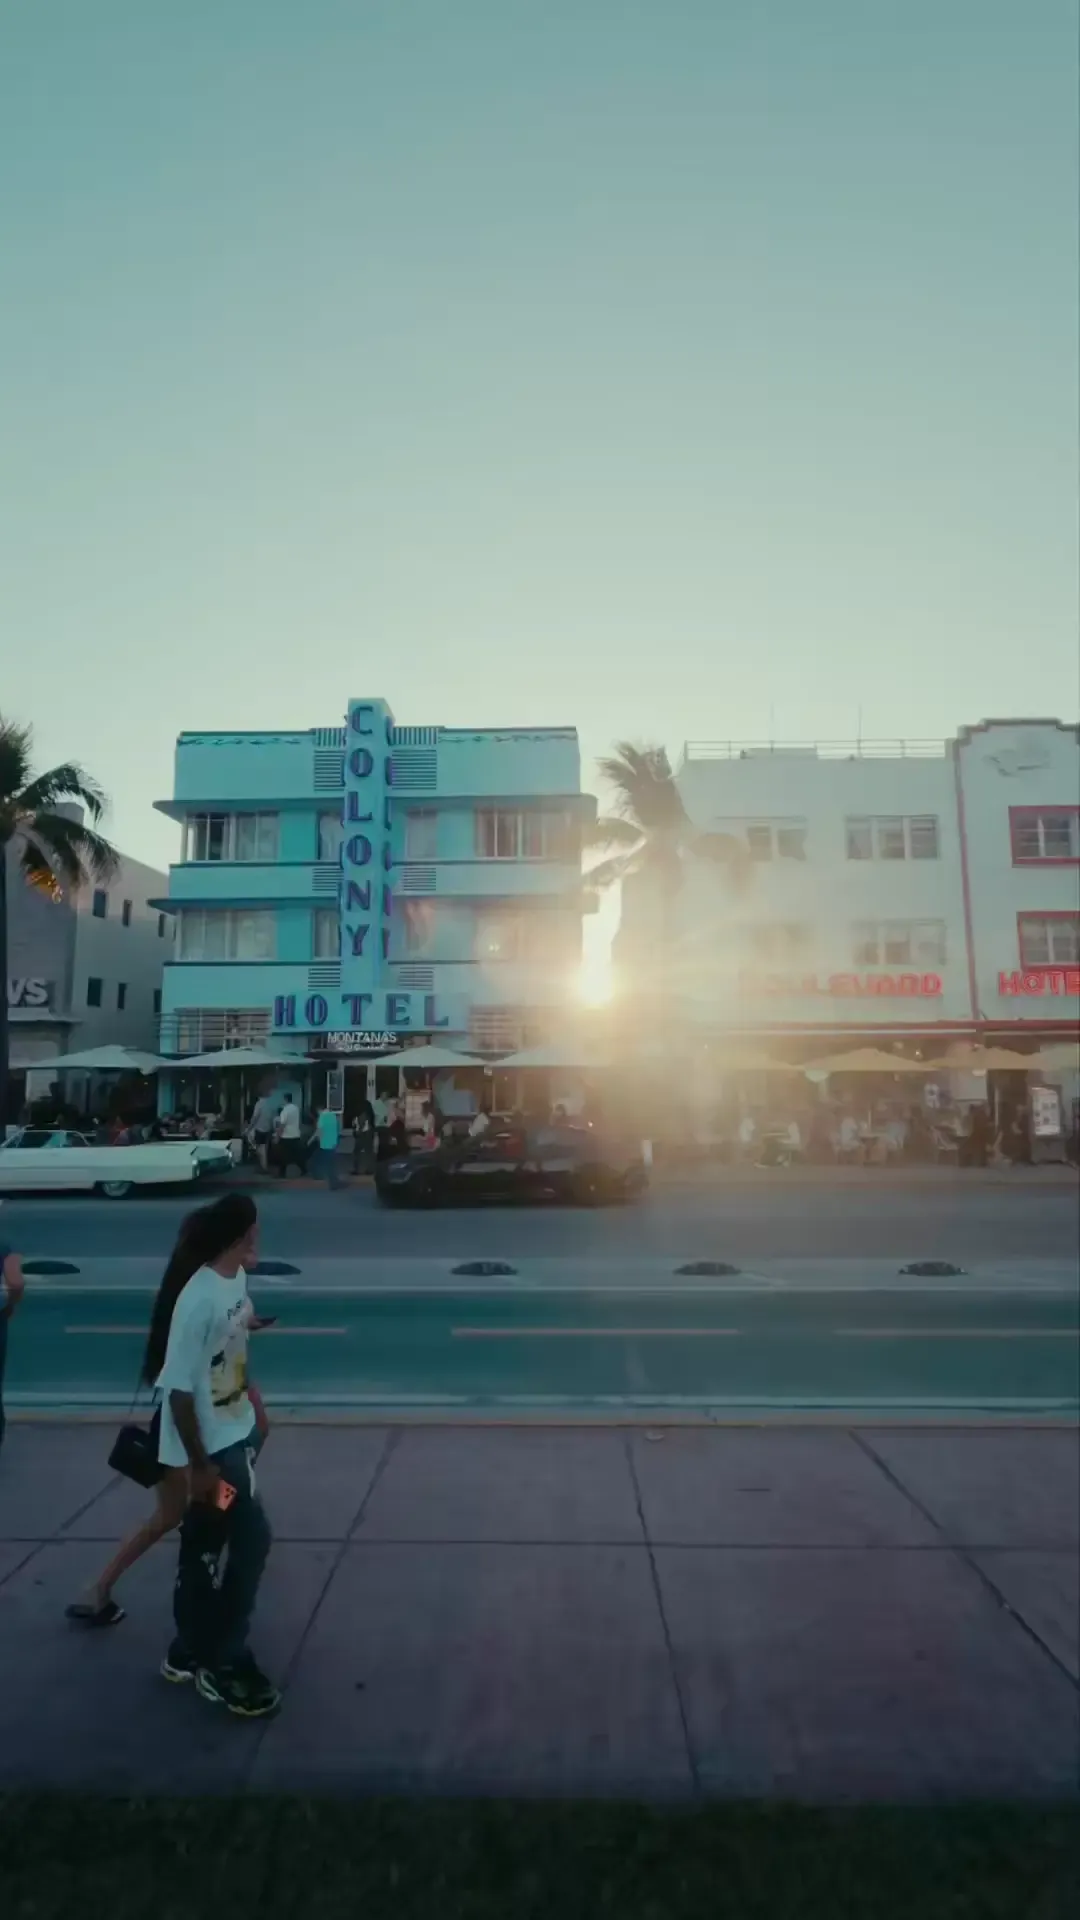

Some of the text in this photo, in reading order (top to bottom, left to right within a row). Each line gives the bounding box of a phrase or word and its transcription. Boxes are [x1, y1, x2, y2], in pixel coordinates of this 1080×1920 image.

[346, 706, 374, 957] COLONY
[738, 971, 943, 998] LEVARD
[275, 993, 449, 1027] HOTEL
